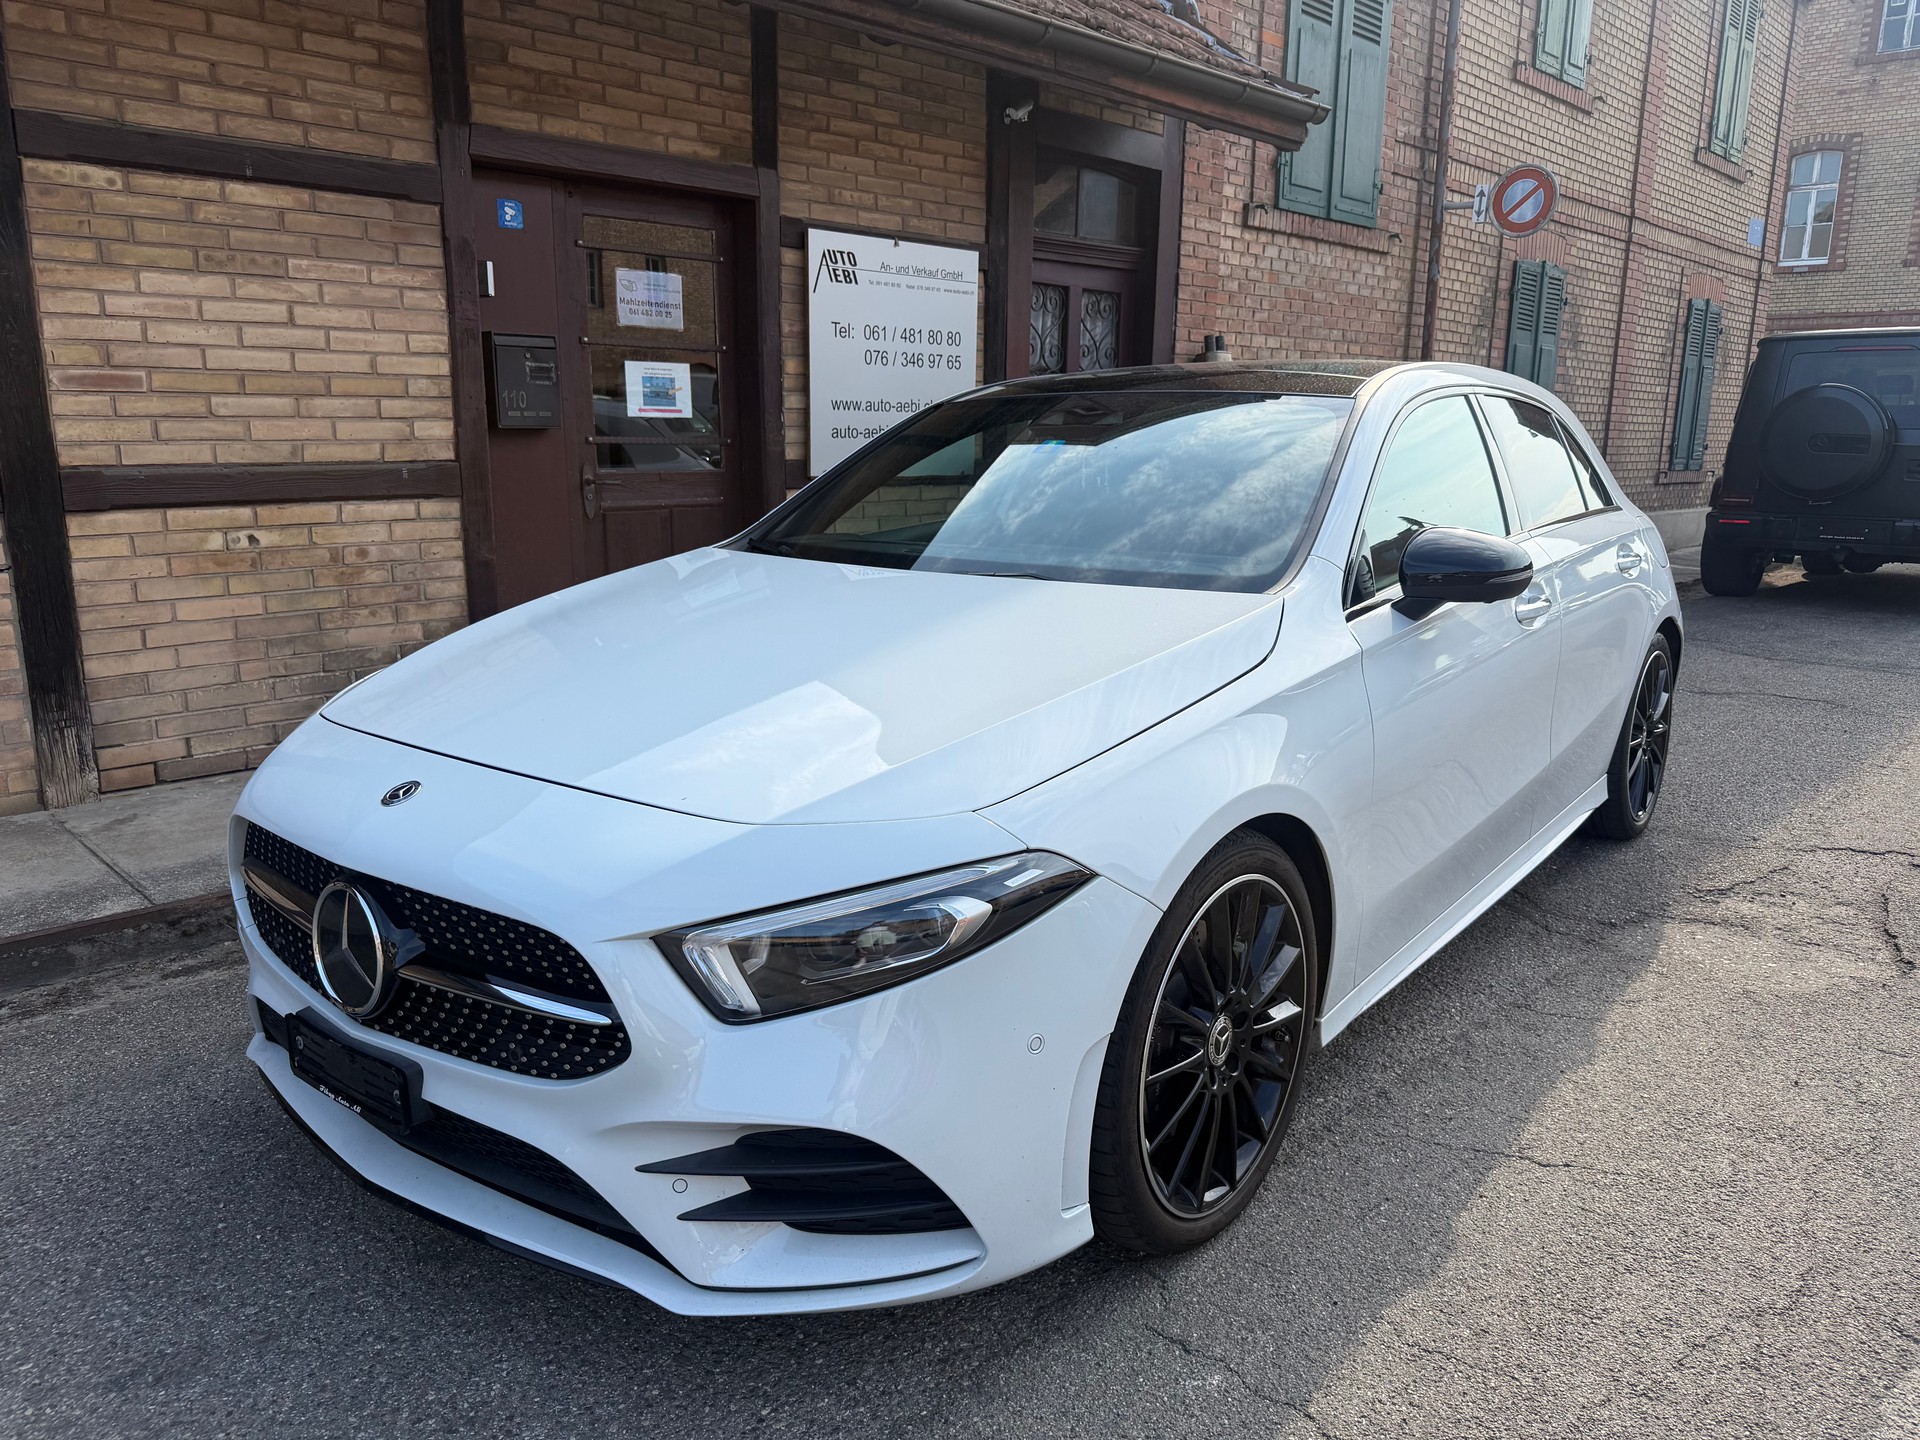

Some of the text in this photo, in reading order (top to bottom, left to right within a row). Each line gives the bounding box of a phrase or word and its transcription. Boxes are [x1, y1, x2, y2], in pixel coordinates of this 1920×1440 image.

[880, 262, 963, 281] An- und Verkauf GmbH
[619, 296, 681, 310] Mahlzeitendienst
[664, 310, 673, 319] 25
[831, 321, 962, 347] Tel: 061 / 481 80 80
[864, 349, 962, 370] 076 / 346 97 65
[502, 390, 527, 409] 110
[831, 425, 889, 439] auto-aeb
